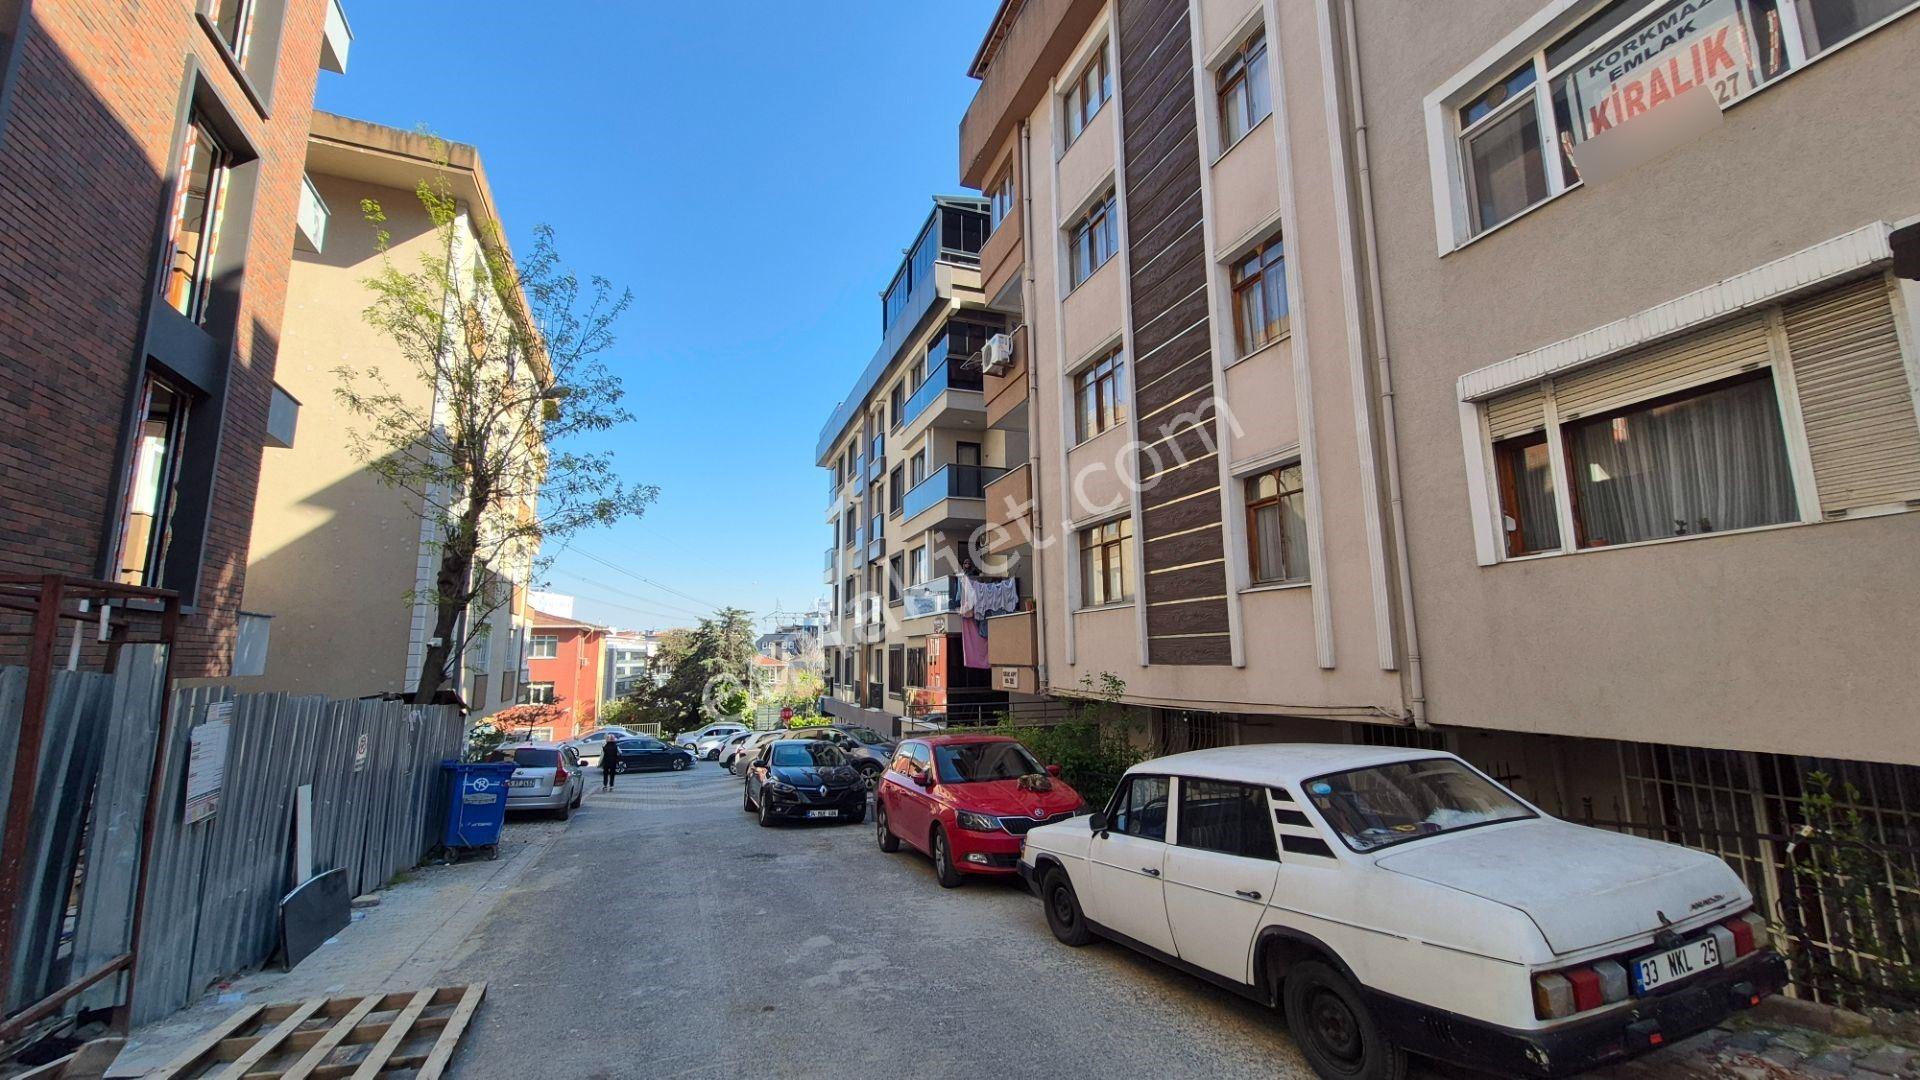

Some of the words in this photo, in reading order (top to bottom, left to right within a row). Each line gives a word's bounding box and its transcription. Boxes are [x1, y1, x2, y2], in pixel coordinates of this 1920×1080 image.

[1589, 0, 1709, 78] KORKMA
[1608, 19, 1697, 82] EMLAK
[1589, 25, 1735, 136] KİRALIK
[1642, 959, 1659, 986] 33
[1667, 949, 1693, 977] NKL
[1700, 939, 1717, 965] 25
